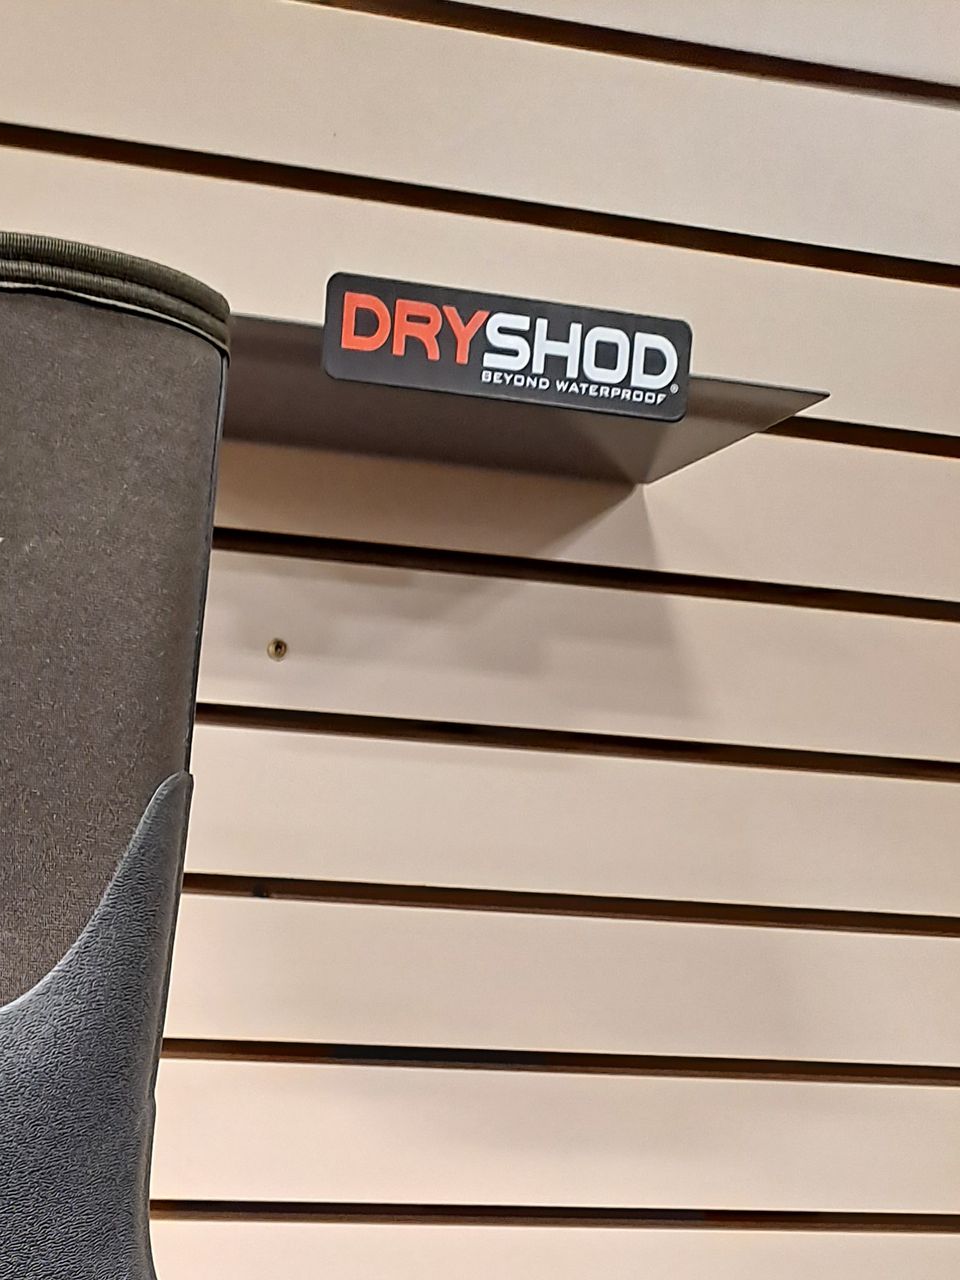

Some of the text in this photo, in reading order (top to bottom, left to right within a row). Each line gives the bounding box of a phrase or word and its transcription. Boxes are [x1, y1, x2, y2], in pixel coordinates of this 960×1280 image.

[341, 291, 679, 390] DRYSHOD
[481, 371, 666, 405] BEYOND WATERPROOF
